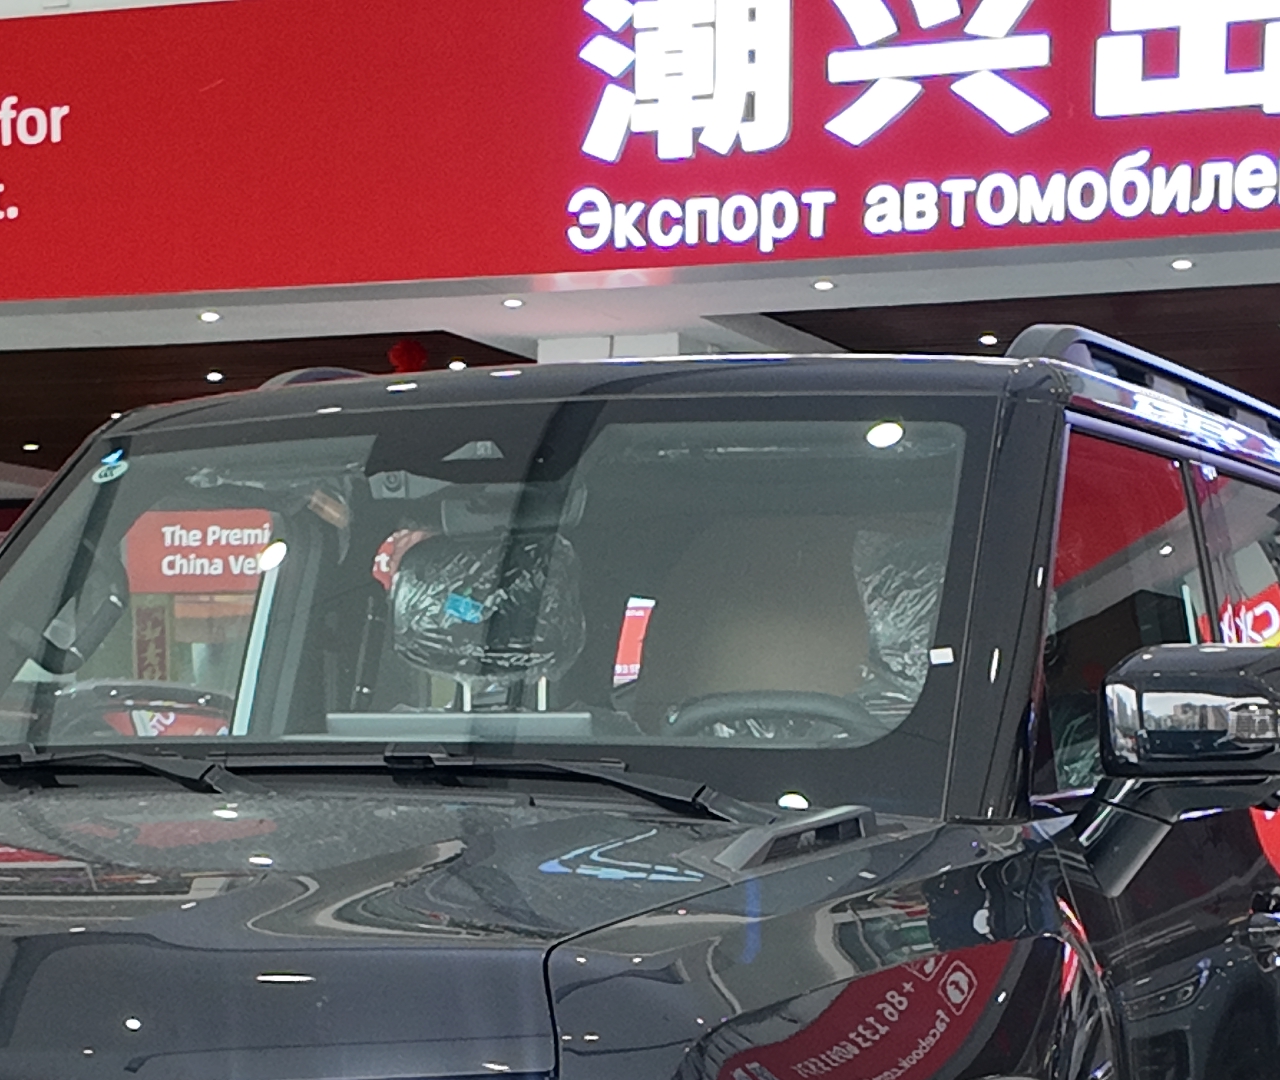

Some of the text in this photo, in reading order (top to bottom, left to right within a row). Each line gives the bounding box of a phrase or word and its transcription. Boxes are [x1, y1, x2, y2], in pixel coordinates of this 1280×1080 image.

[566, 187, 835, 252] Экспорт
[161, 525, 202, 547] The
[162, 554, 223, 576] China
